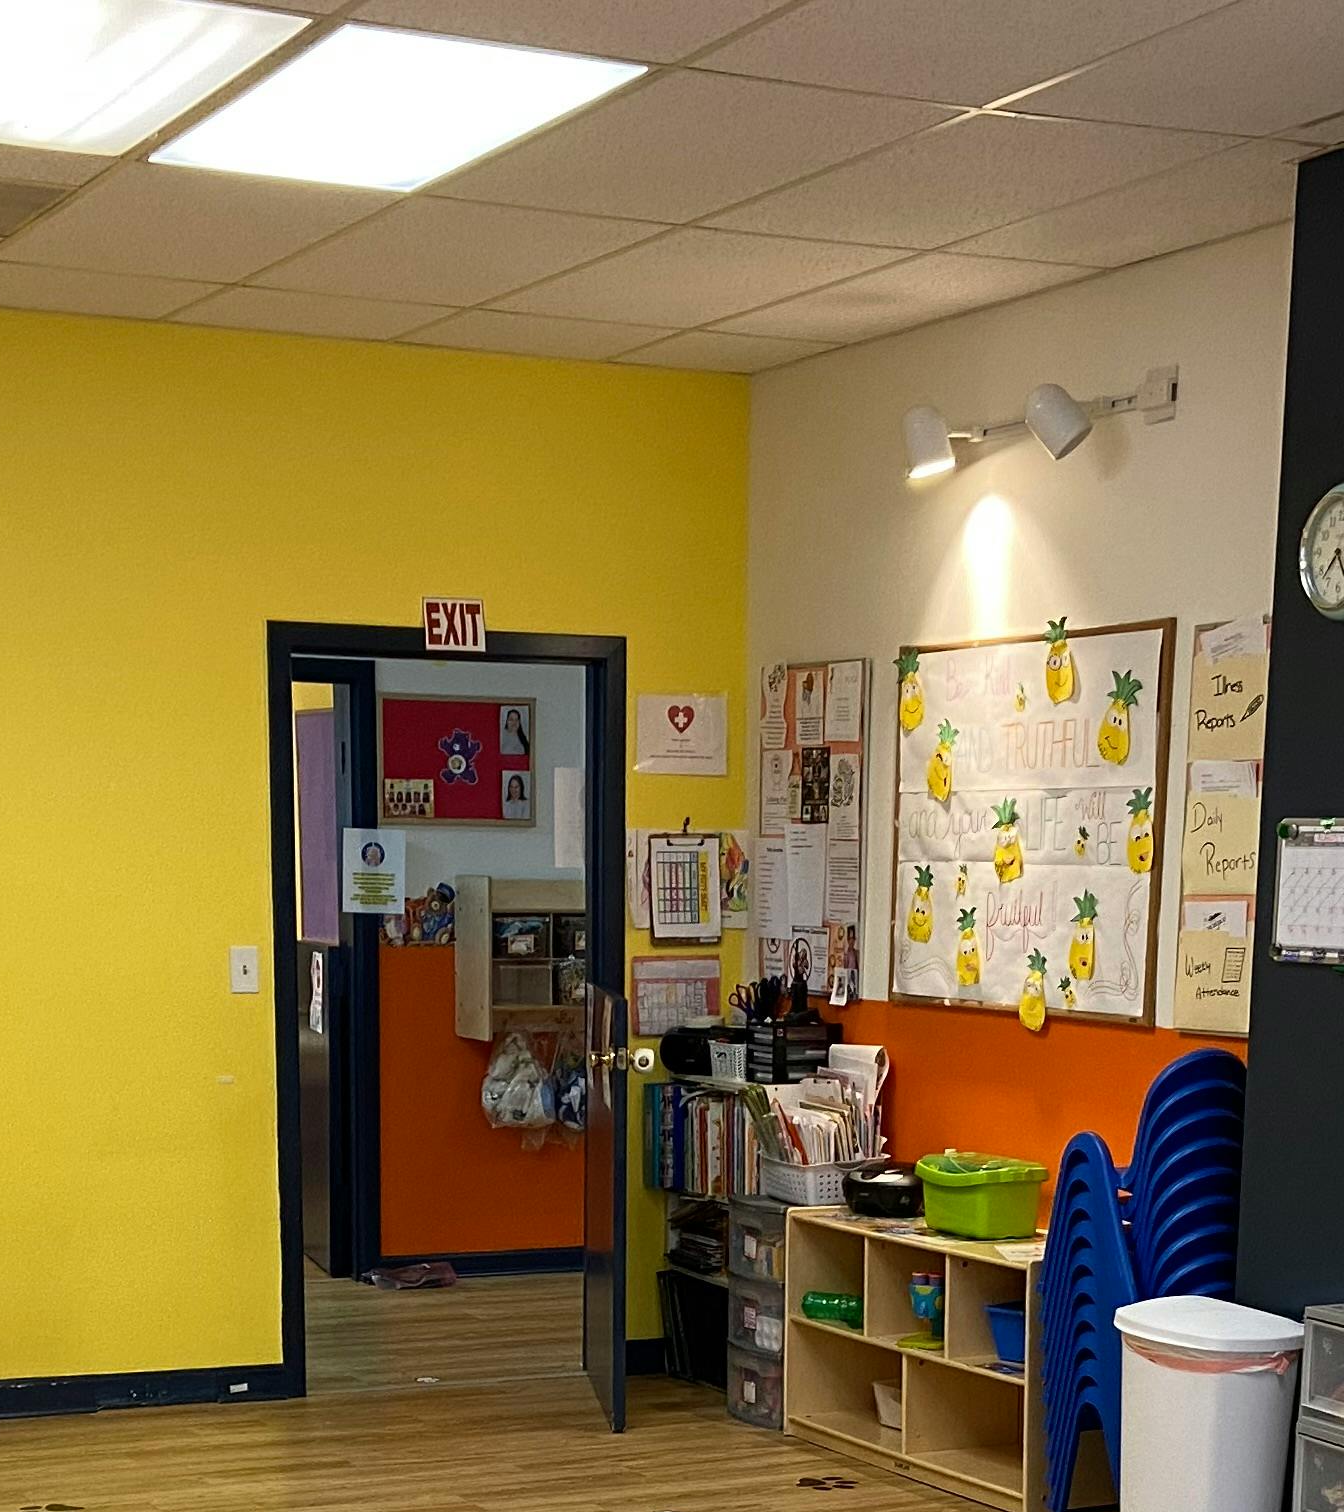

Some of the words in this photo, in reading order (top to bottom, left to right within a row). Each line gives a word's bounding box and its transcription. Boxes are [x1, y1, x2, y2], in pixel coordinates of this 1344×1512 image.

[425, 602, 482, 647] EXIT
[1196, 709, 1236, 732] Reports
[1001, 717, 1100, 770] TRUTHFUL
[1024, 794, 1068, 852] LIFE
[1074, 791, 1106, 819] will
[1189, 802, 1224, 835] Daily
[1096, 821, 1123, 866] BE
[1201, 841, 1257, 881] Reports
[1184, 955, 1212, 979] Weekly
[1195, 986, 1240, 999] Attendance
